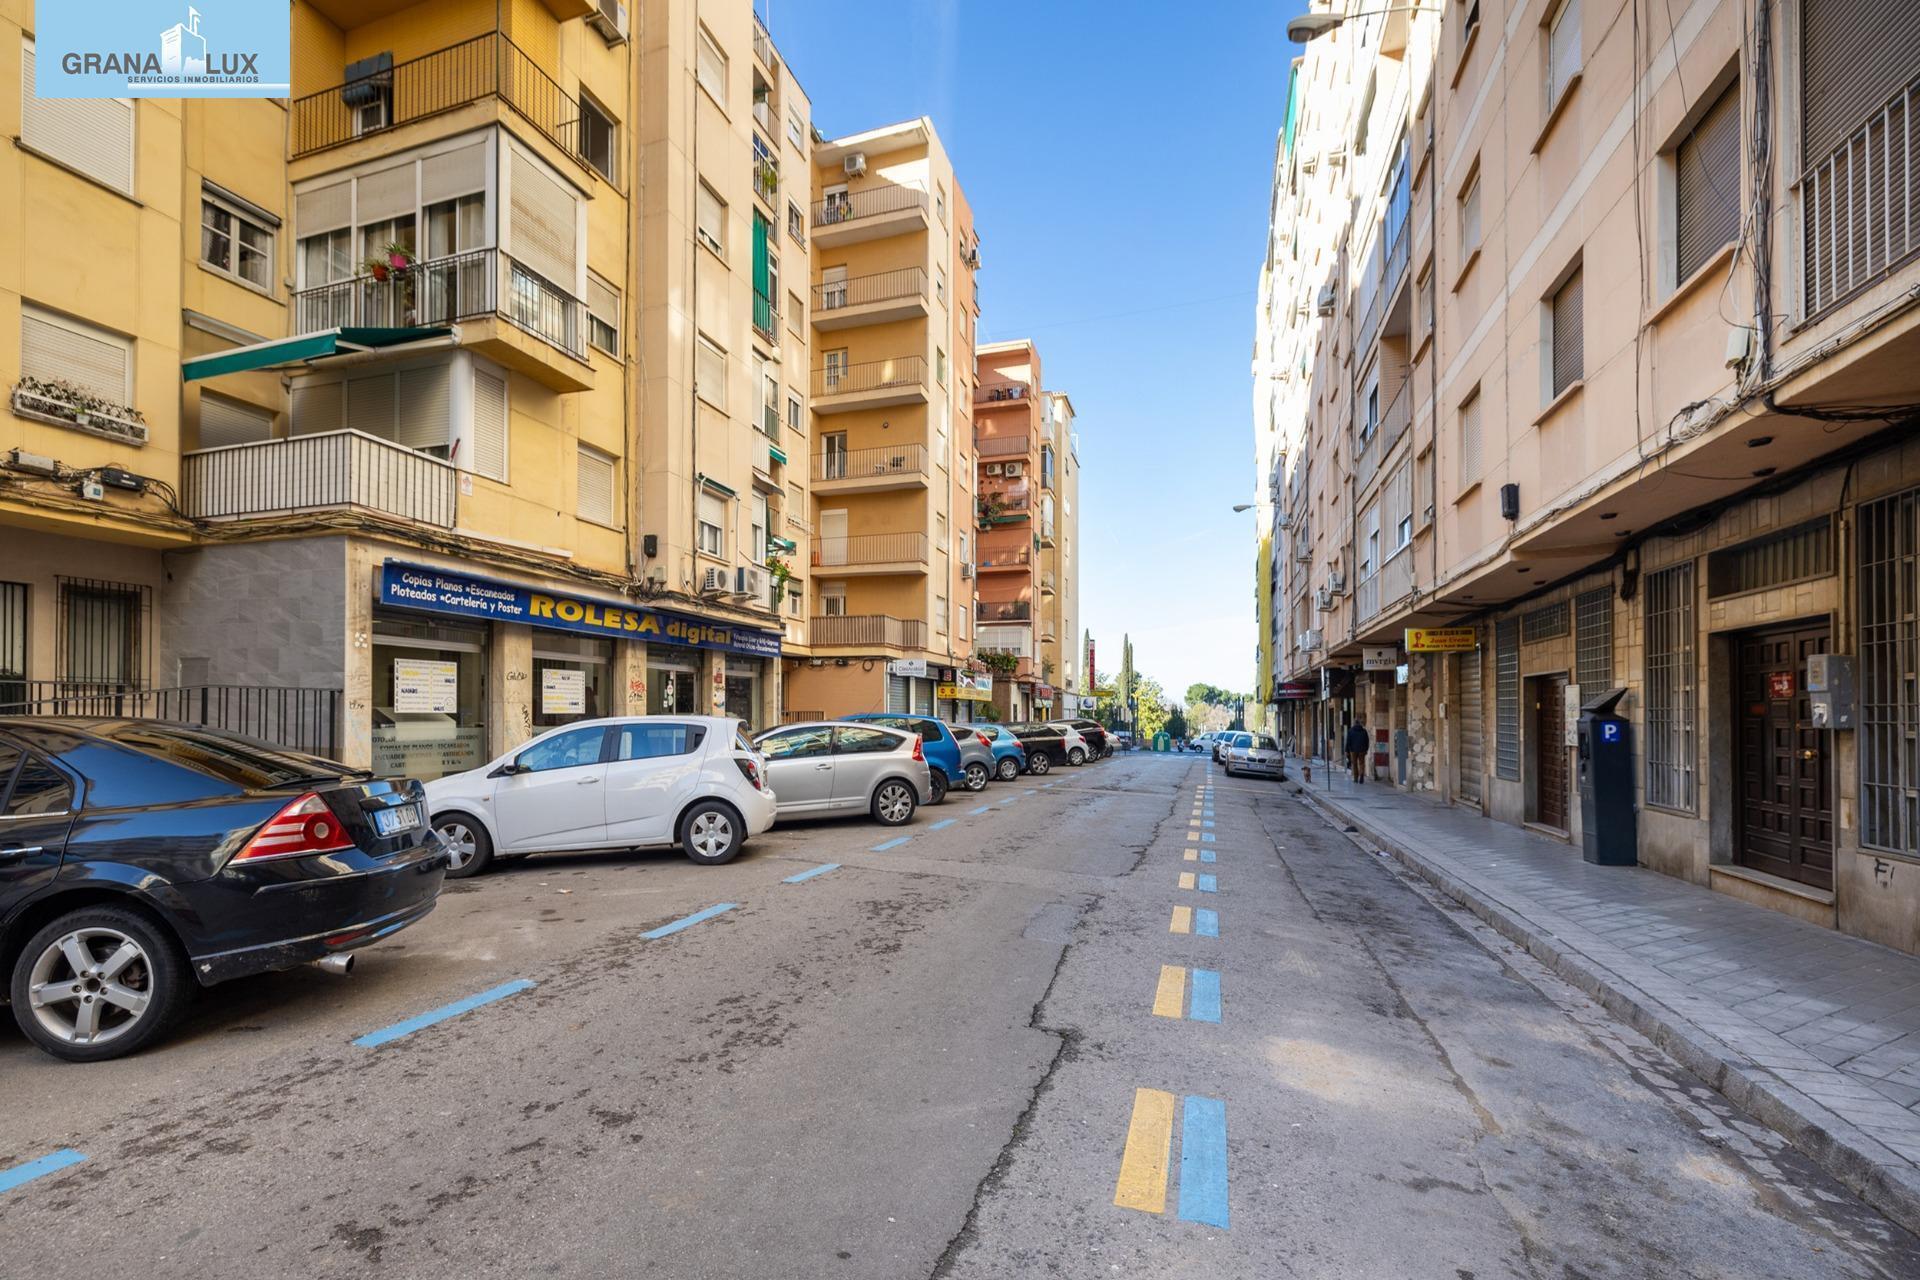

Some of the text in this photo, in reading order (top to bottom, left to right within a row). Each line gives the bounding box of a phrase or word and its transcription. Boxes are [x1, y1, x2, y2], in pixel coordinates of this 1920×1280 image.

[390, 584, 523, 615] Ploteados Cartelería y Poster
[402, 572, 515, 602] Copias Planos Escaneados
[529, 594, 731, 645] ROLESA digital
[1604, 724, 1617, 739] P
